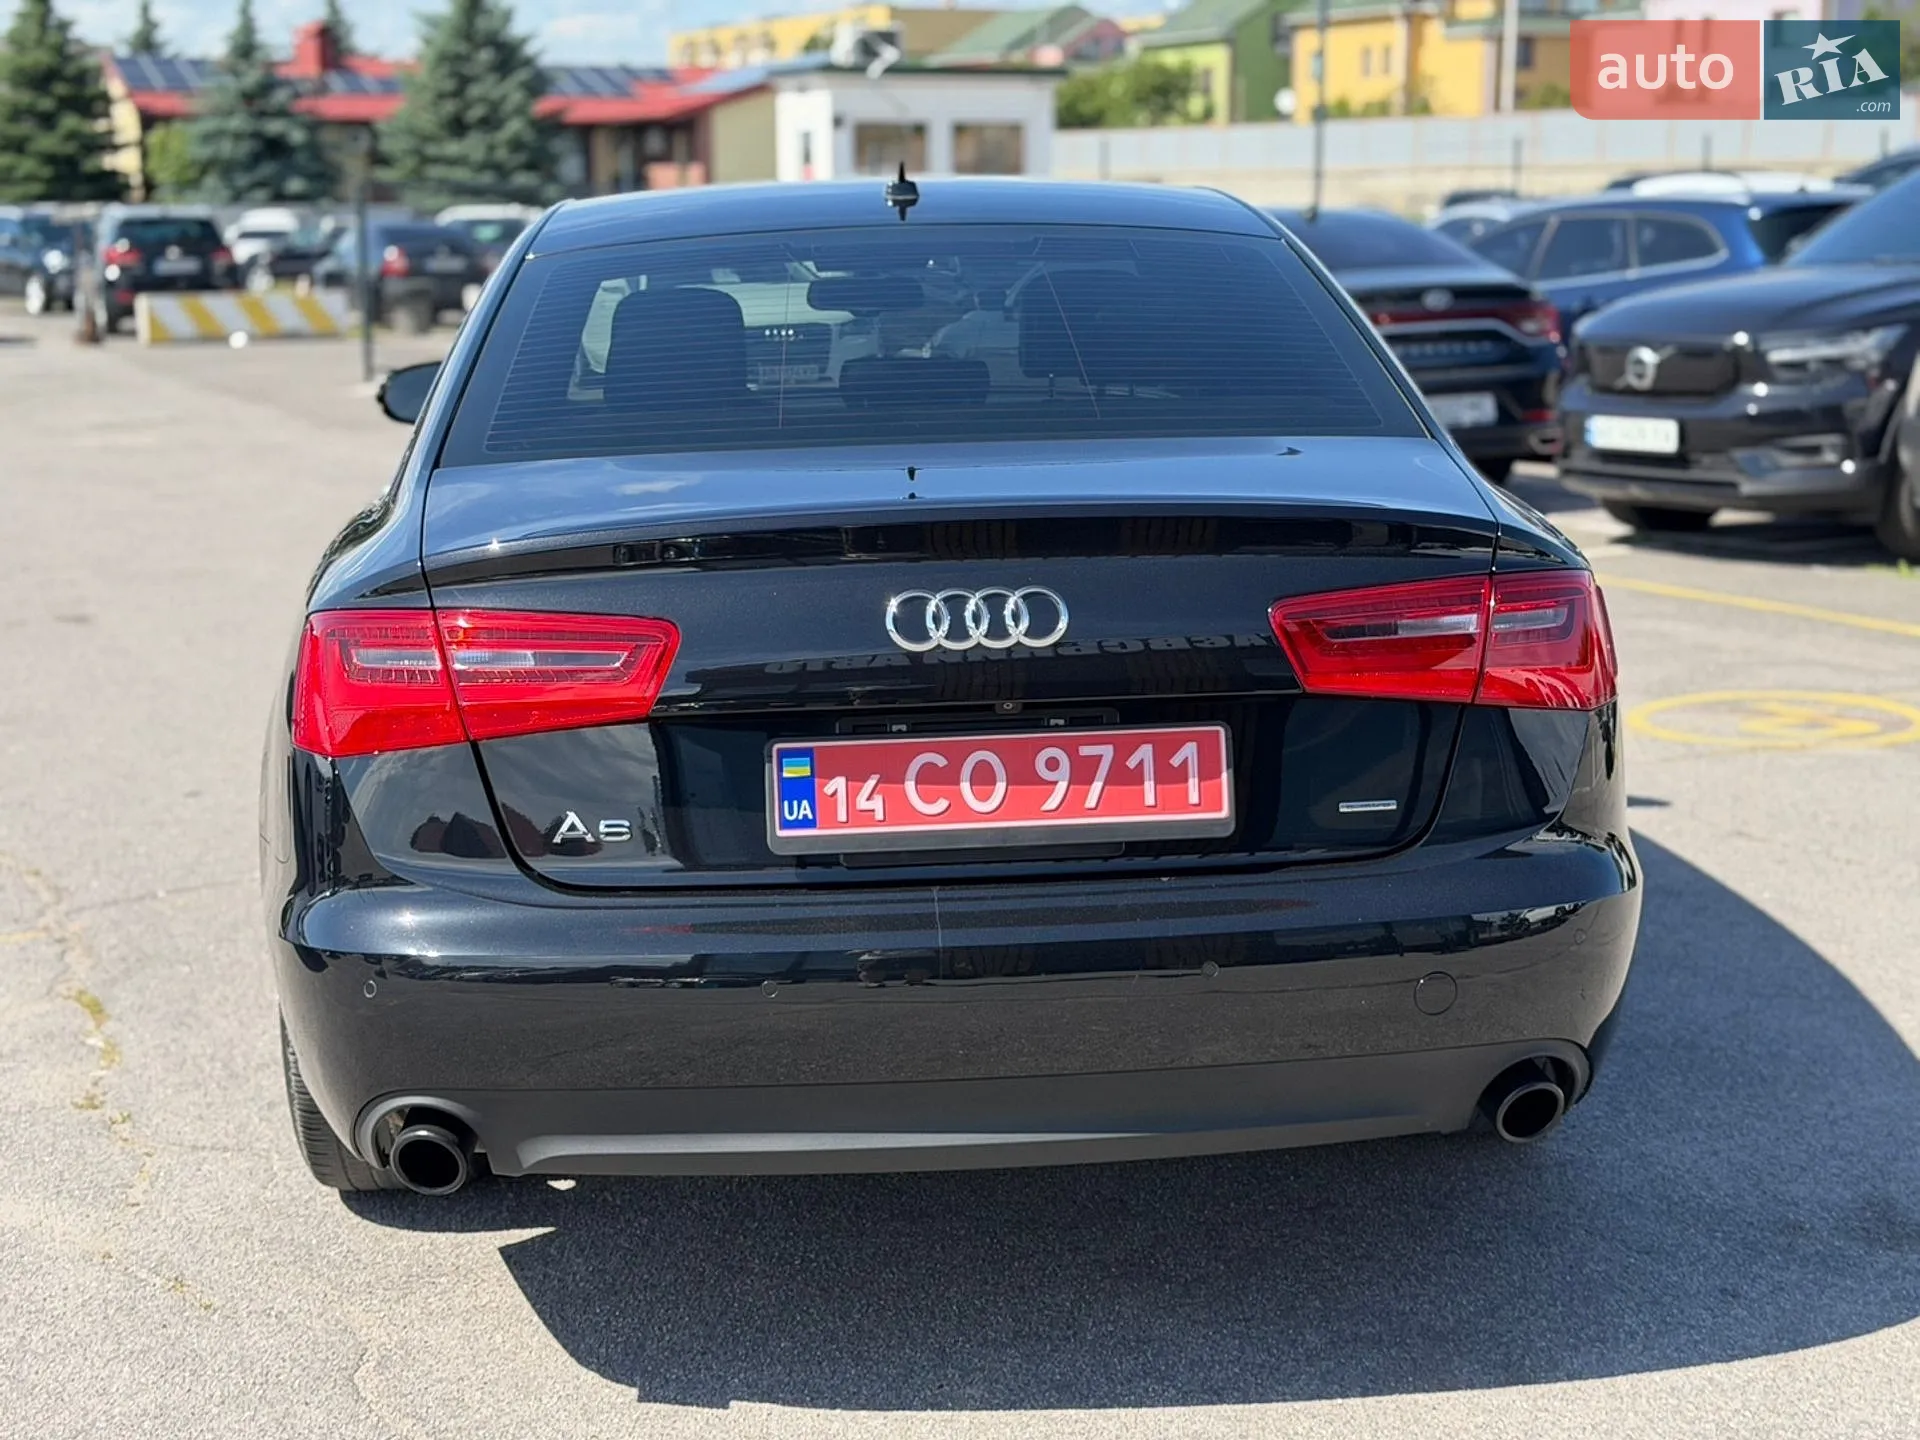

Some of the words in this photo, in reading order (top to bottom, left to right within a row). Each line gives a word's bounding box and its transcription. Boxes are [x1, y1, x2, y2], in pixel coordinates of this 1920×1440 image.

[824, 776, 884, 822] 14
[904, 750, 1007, 816] CO
[1034, 741, 1199, 811] 9711
[783, 800, 813, 821] UA
[552, 811, 632, 843] A6
